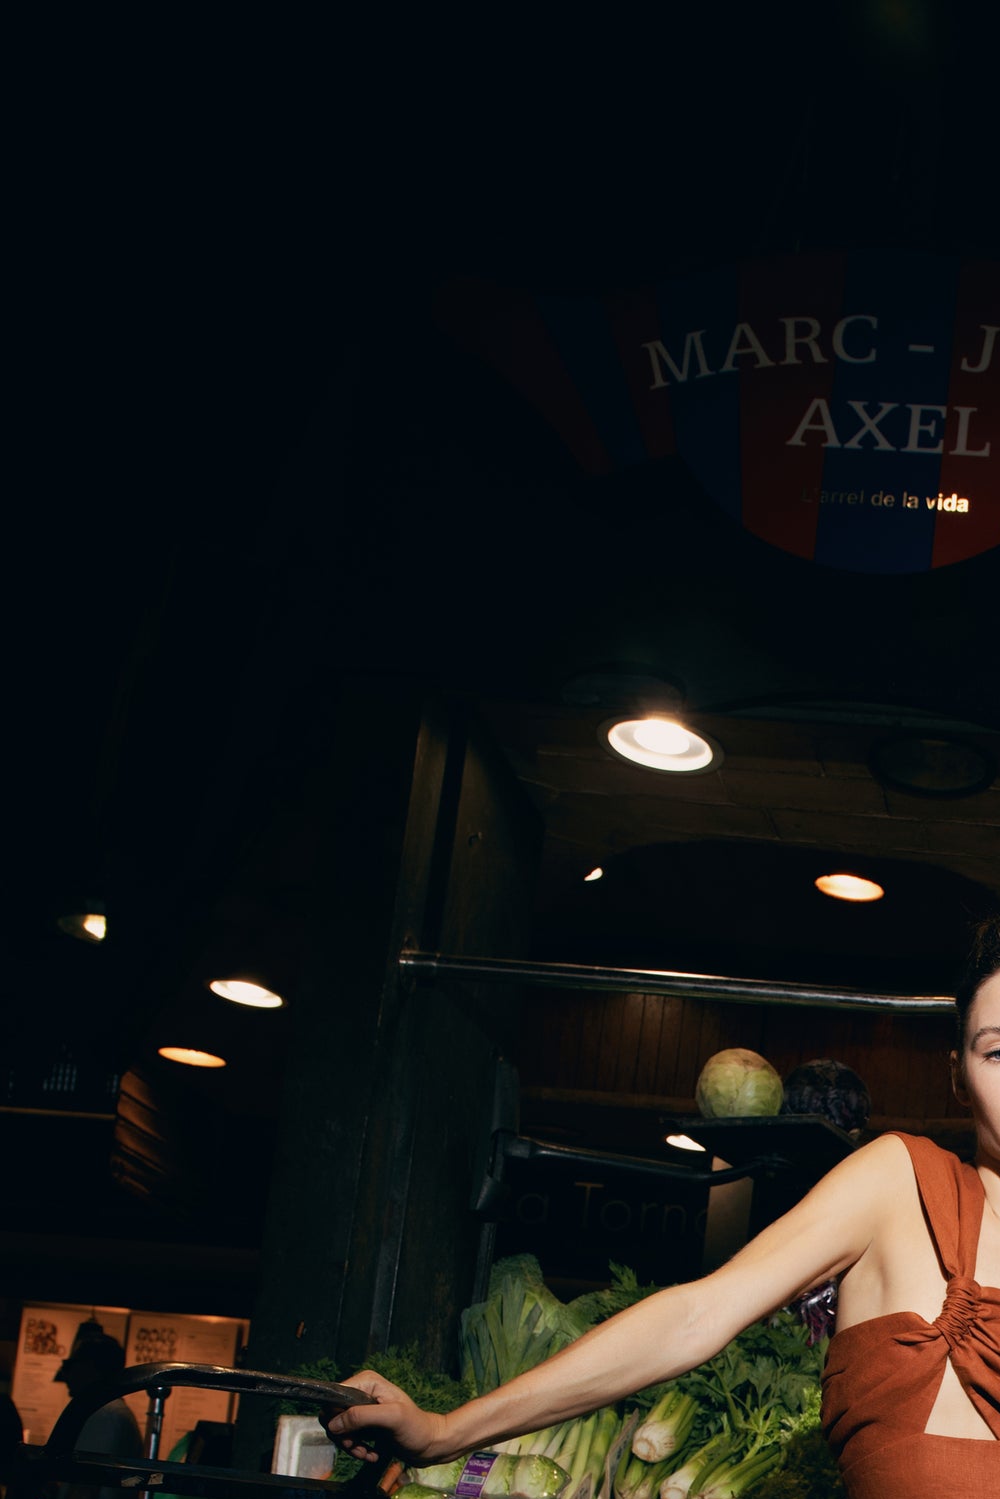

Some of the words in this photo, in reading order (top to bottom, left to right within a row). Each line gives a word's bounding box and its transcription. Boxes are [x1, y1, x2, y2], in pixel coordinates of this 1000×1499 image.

[642, 315, 877, 389] MARC
[786, 398, 991, 457] AXEL
[871, 490, 896, 507] de
[902, 491, 919, 509] la
[925, 493, 970, 513] vida
